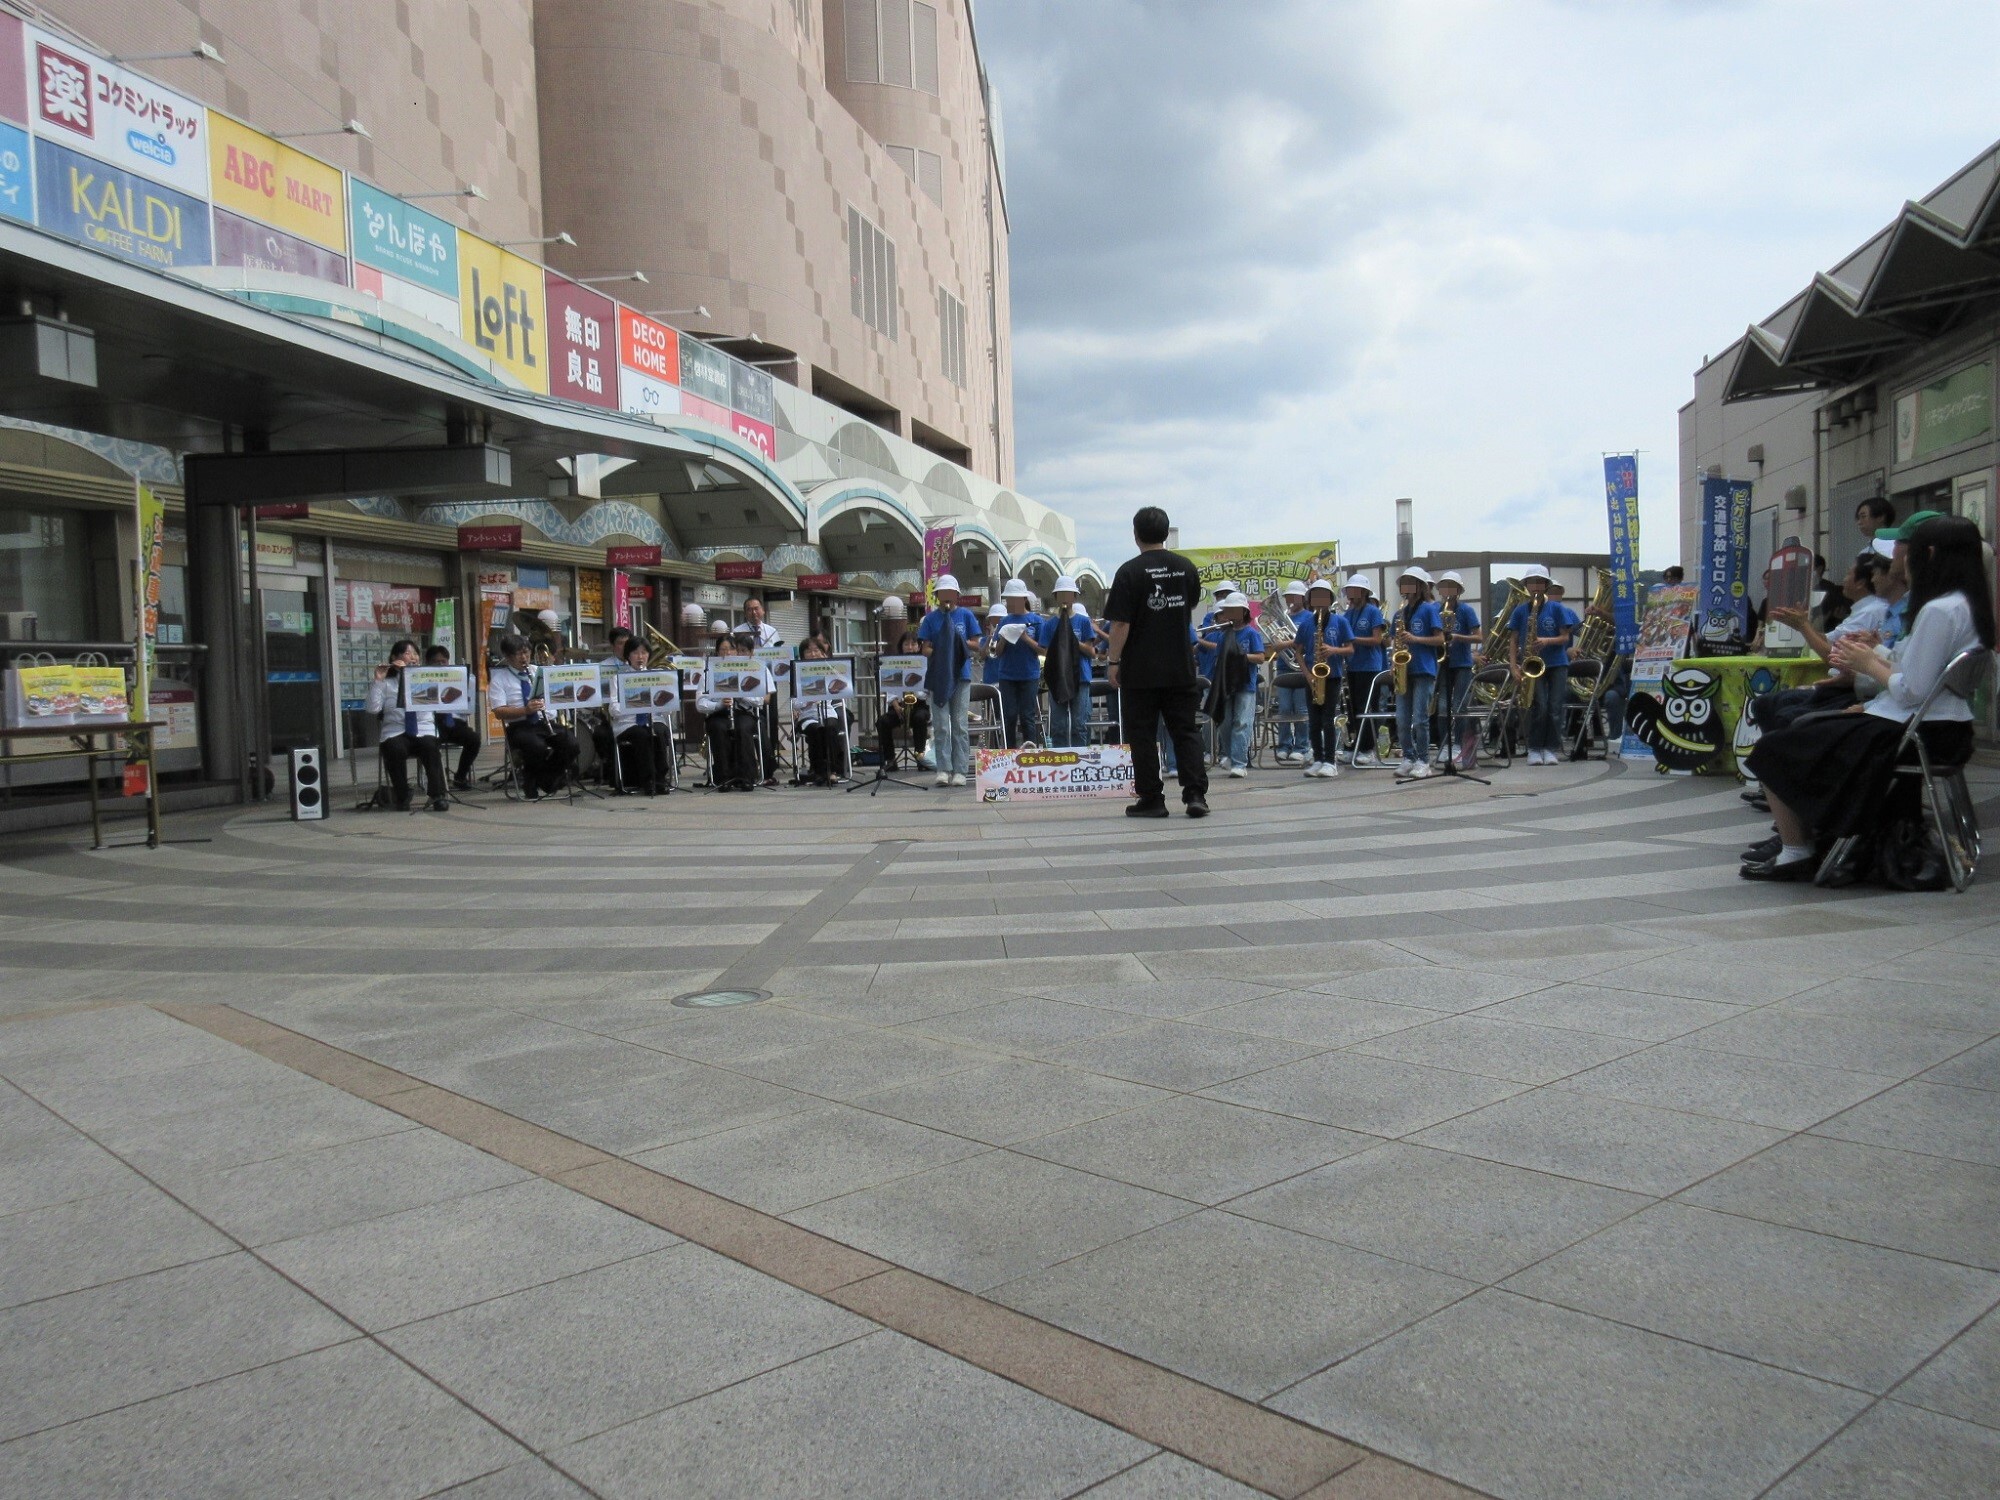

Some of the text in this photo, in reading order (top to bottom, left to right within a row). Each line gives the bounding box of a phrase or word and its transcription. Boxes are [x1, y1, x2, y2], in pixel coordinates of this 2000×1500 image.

[43, 54, 88, 128] 薬
[97, 74, 197, 139] コクミンドラッグ
[224, 144, 333, 217] ABC MART
[71, 167, 181, 249] KALDI
[565, 305, 600, 351] 無印
[632, 318, 666, 350] DECO
[567, 349, 602, 394] 良品
[633, 344, 667, 374] HOME
[478, 574, 507, 584] たばこ
[1013, 783, 1124, 794] 秋の交通安全市民運動スタート式
